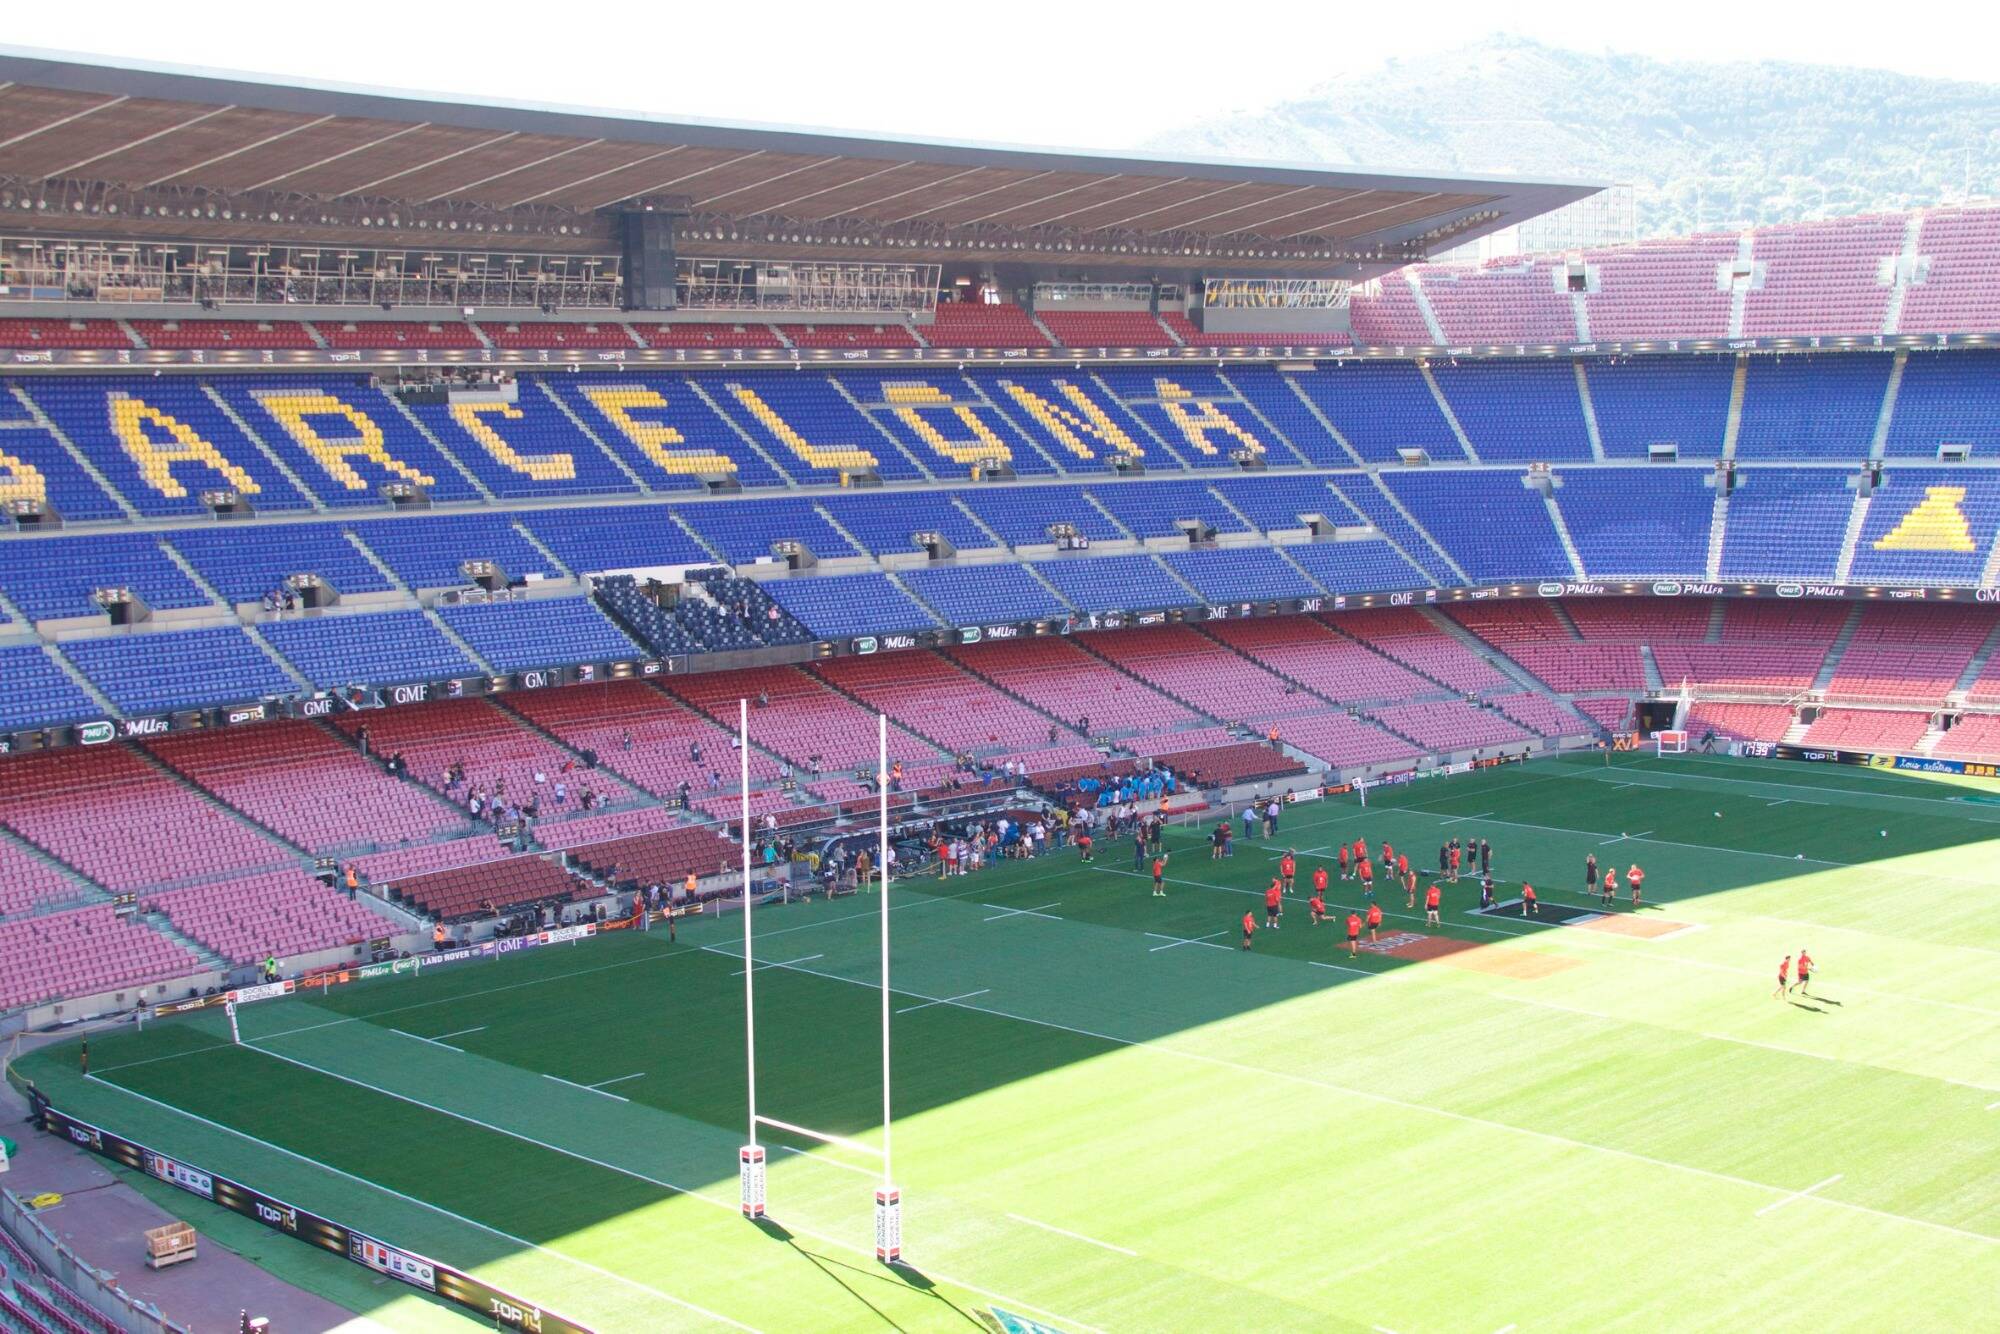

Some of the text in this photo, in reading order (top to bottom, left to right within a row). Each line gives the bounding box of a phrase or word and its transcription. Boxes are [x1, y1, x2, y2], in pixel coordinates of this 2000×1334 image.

[1390, 593, 1413, 605] GMF
[1975, 588, 2000, 601] GM
[526, 672, 548, 688] GM
[395, 685, 428, 703] GMF
[230, 706, 265, 723] OP14
[304, 700, 332, 716] GMF
[1803, 751, 1838, 763] TOP14
[499, 939, 523, 953] GMF
[422, 955, 444, 966] LAND
[444, 950, 470, 962] ROVER
[68, 1126, 103, 1150] TOP14
[255, 1202, 297, 1232] TOP14
[490, 1298, 542, 1333] TOP14
